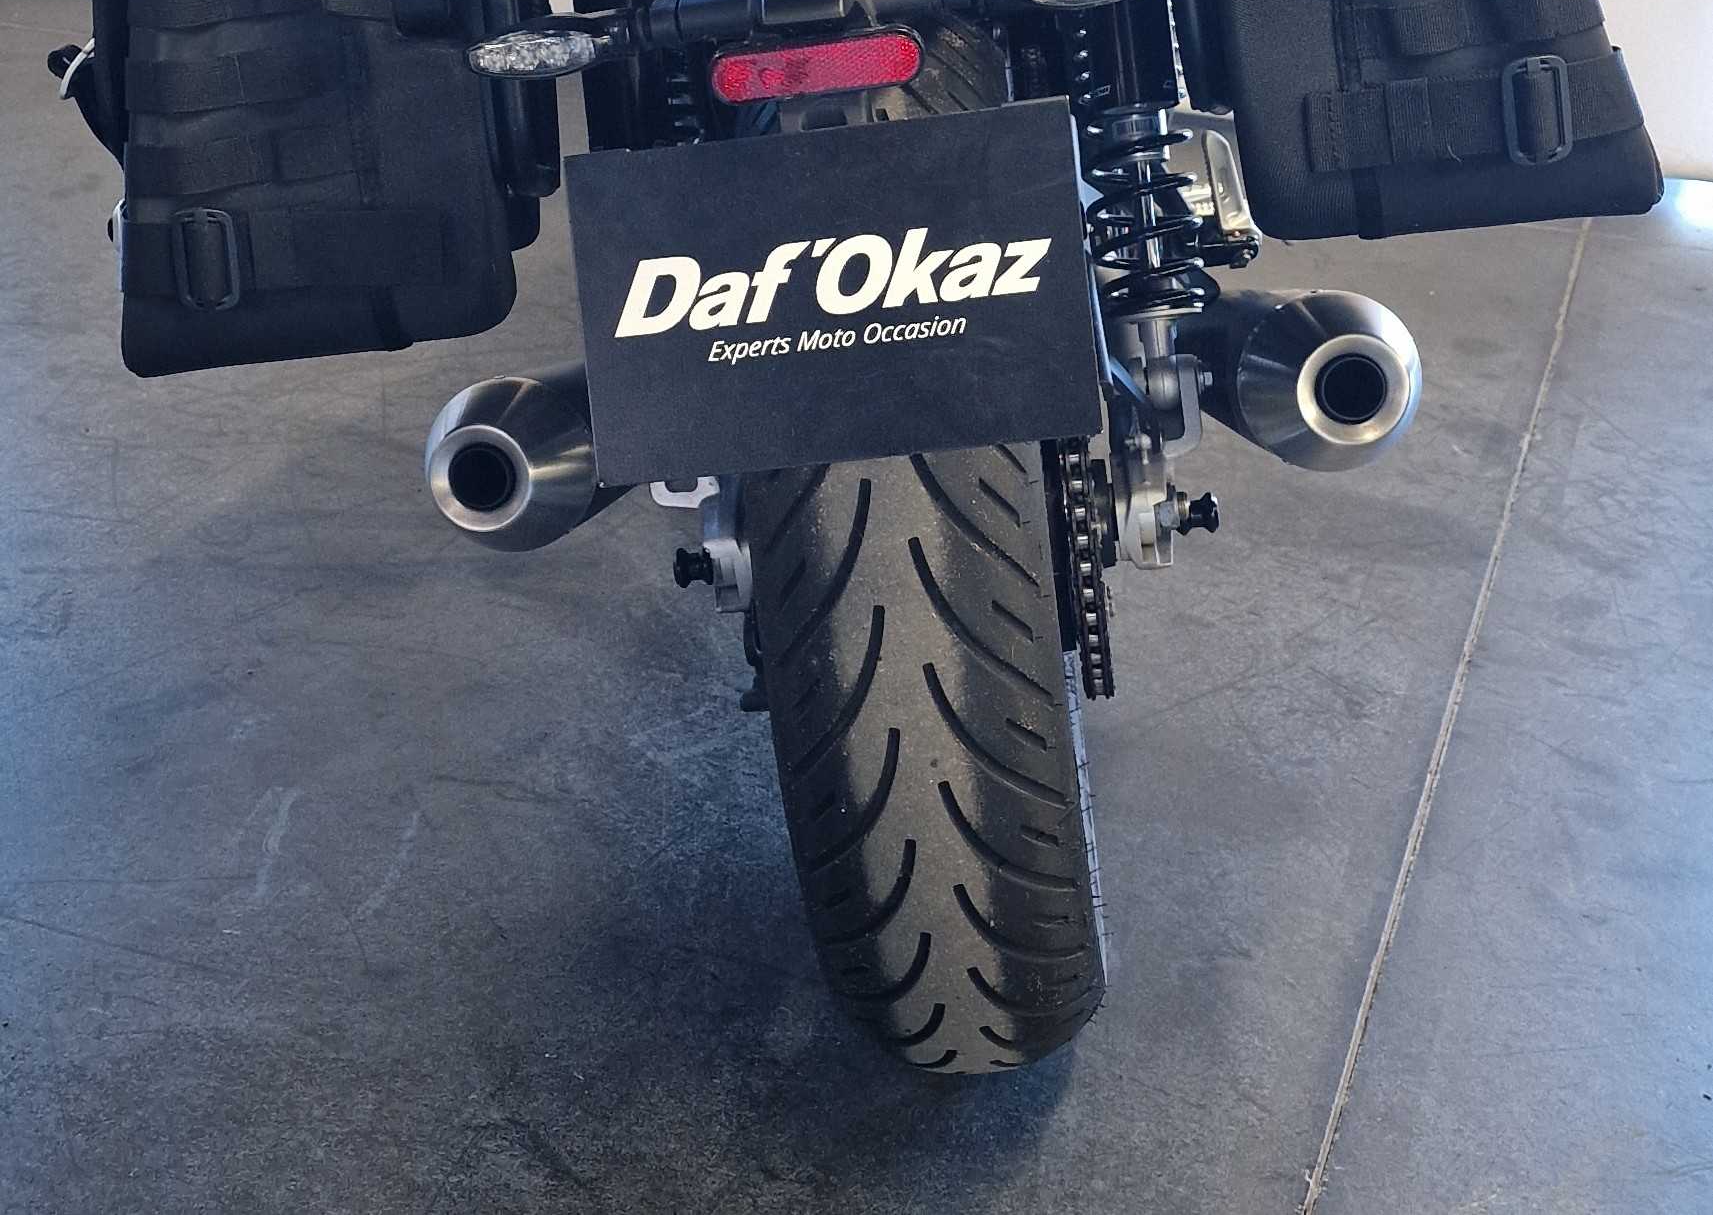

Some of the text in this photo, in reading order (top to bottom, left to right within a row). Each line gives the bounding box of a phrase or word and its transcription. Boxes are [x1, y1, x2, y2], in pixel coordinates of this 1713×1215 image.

[614, 228, 1053, 339] Daf'Okaz
[708, 316, 967, 366] Experts Moto Occasion
